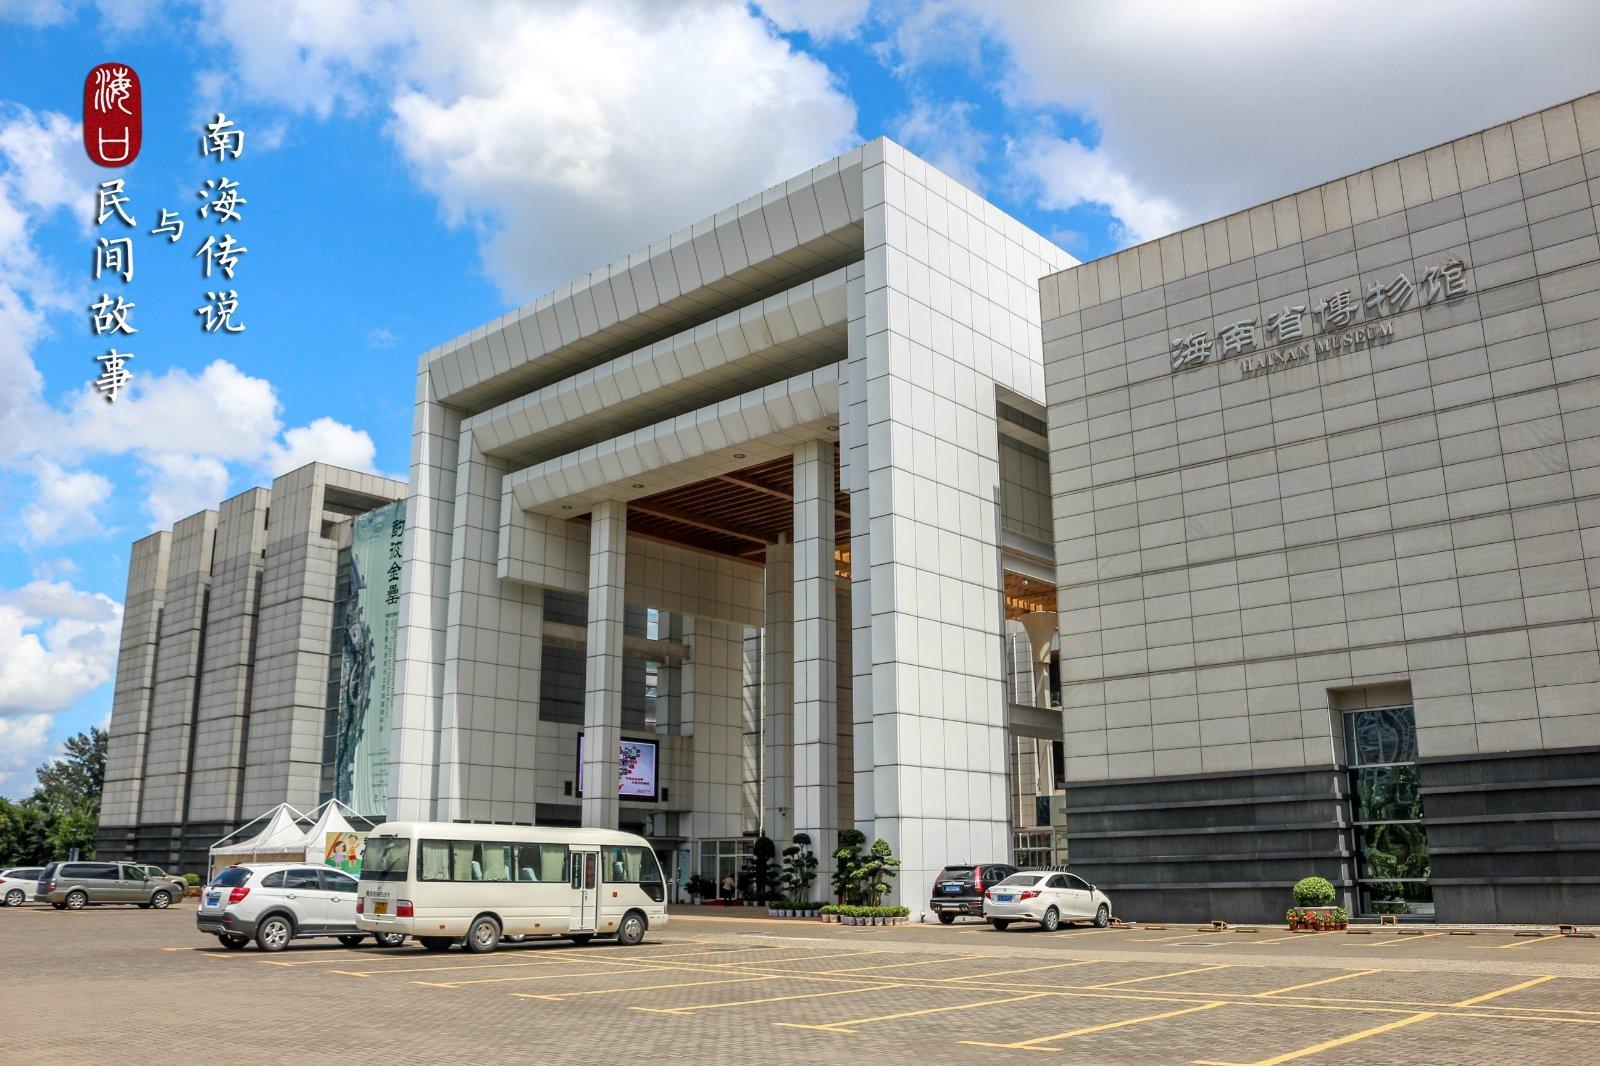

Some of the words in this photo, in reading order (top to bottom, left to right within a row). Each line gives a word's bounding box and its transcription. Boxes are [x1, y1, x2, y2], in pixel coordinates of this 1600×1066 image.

[1171, 256, 1468, 370] 海南省博物馆
[1241, 344, 1310, 373] HAINAN
[1315, 322, 1394, 355] MUSEUM
